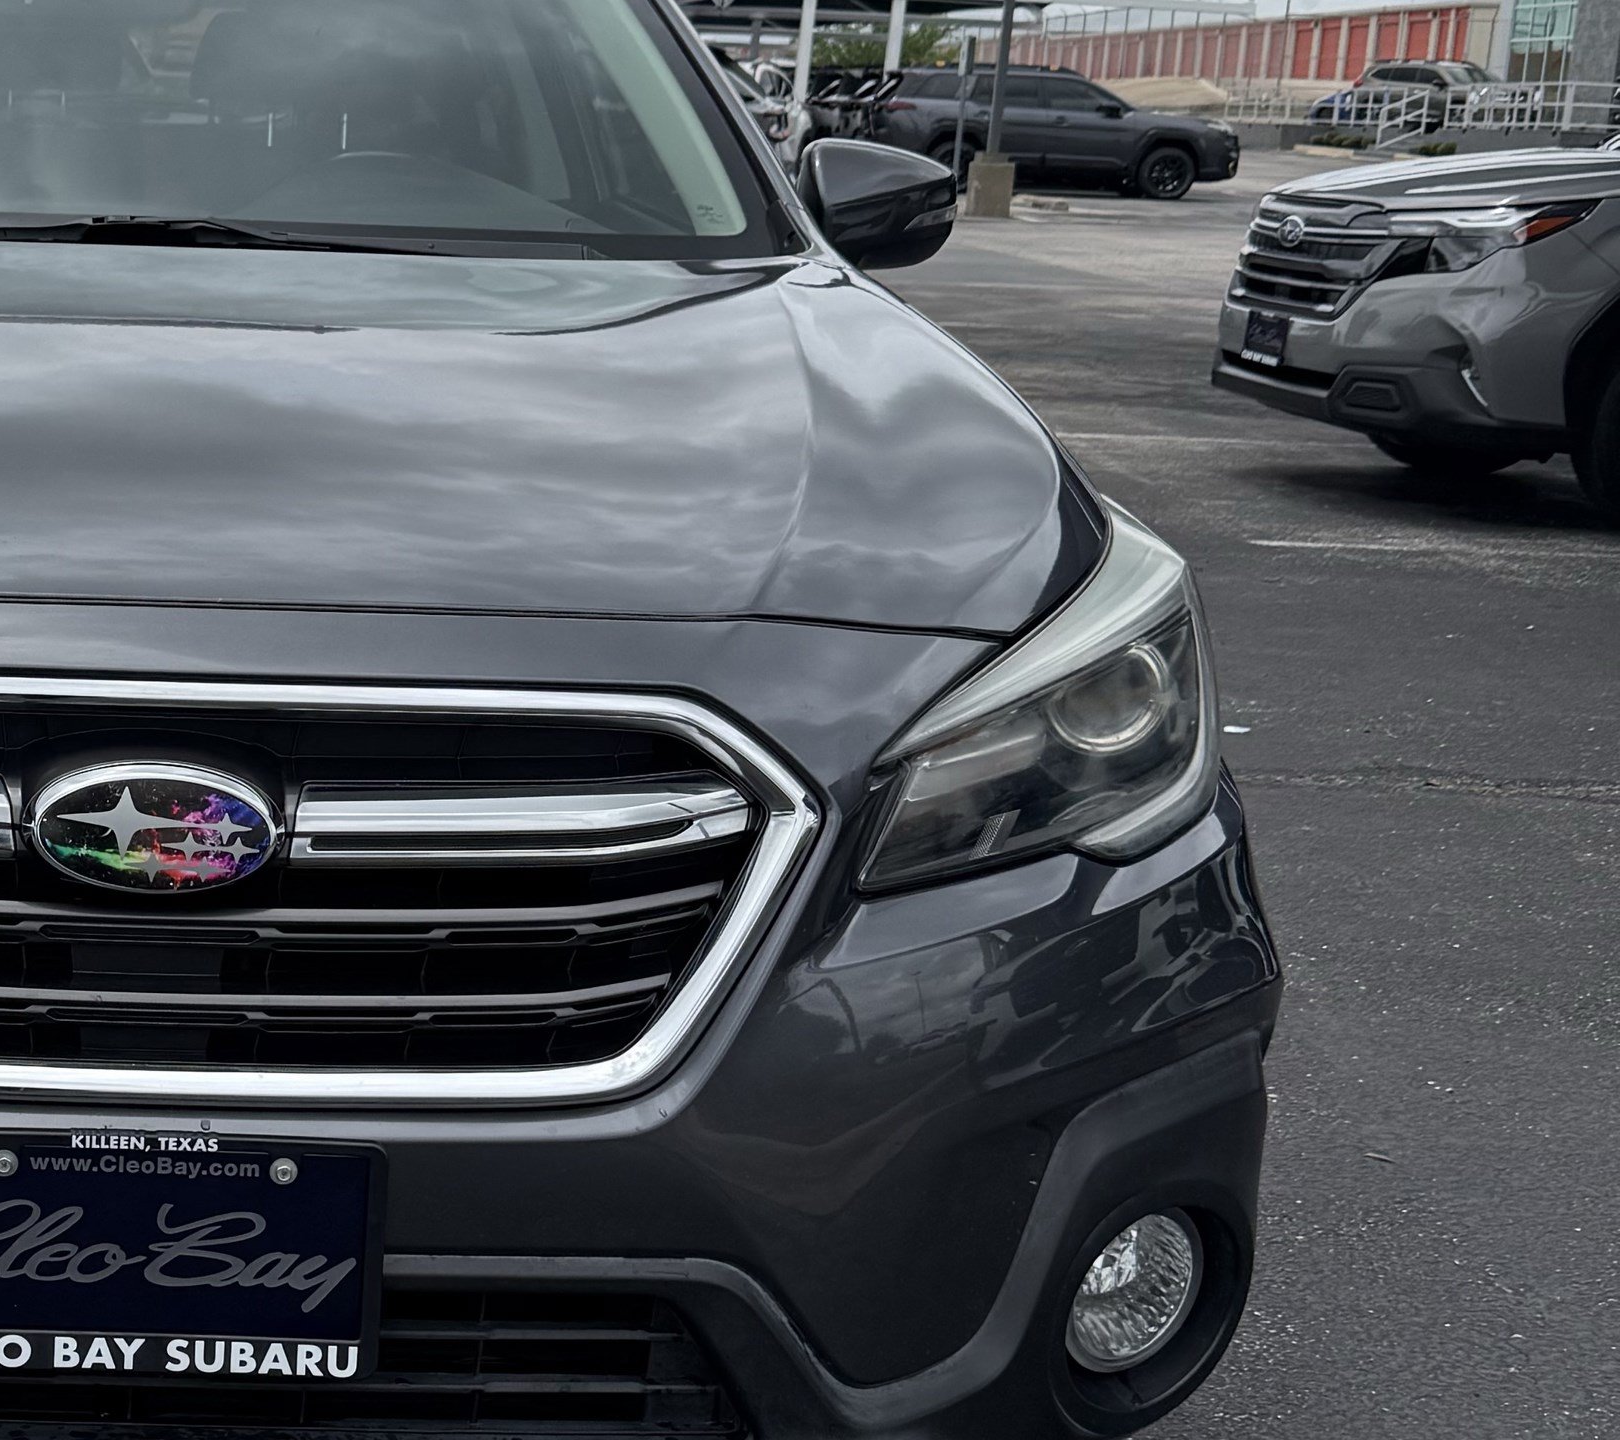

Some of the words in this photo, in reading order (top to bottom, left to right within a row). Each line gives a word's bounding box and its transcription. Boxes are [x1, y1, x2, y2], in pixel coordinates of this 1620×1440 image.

[71, 1134, 151, 1152] KILLEEN,
[158, 1137, 219, 1152] TEXAS
[29, 1153, 261, 1179] www.CleoBay.com
[143, 1203, 357, 1313] Bay
[53, 1336, 146, 1370] BAY
[165, 1339, 360, 1378] SUBARU
